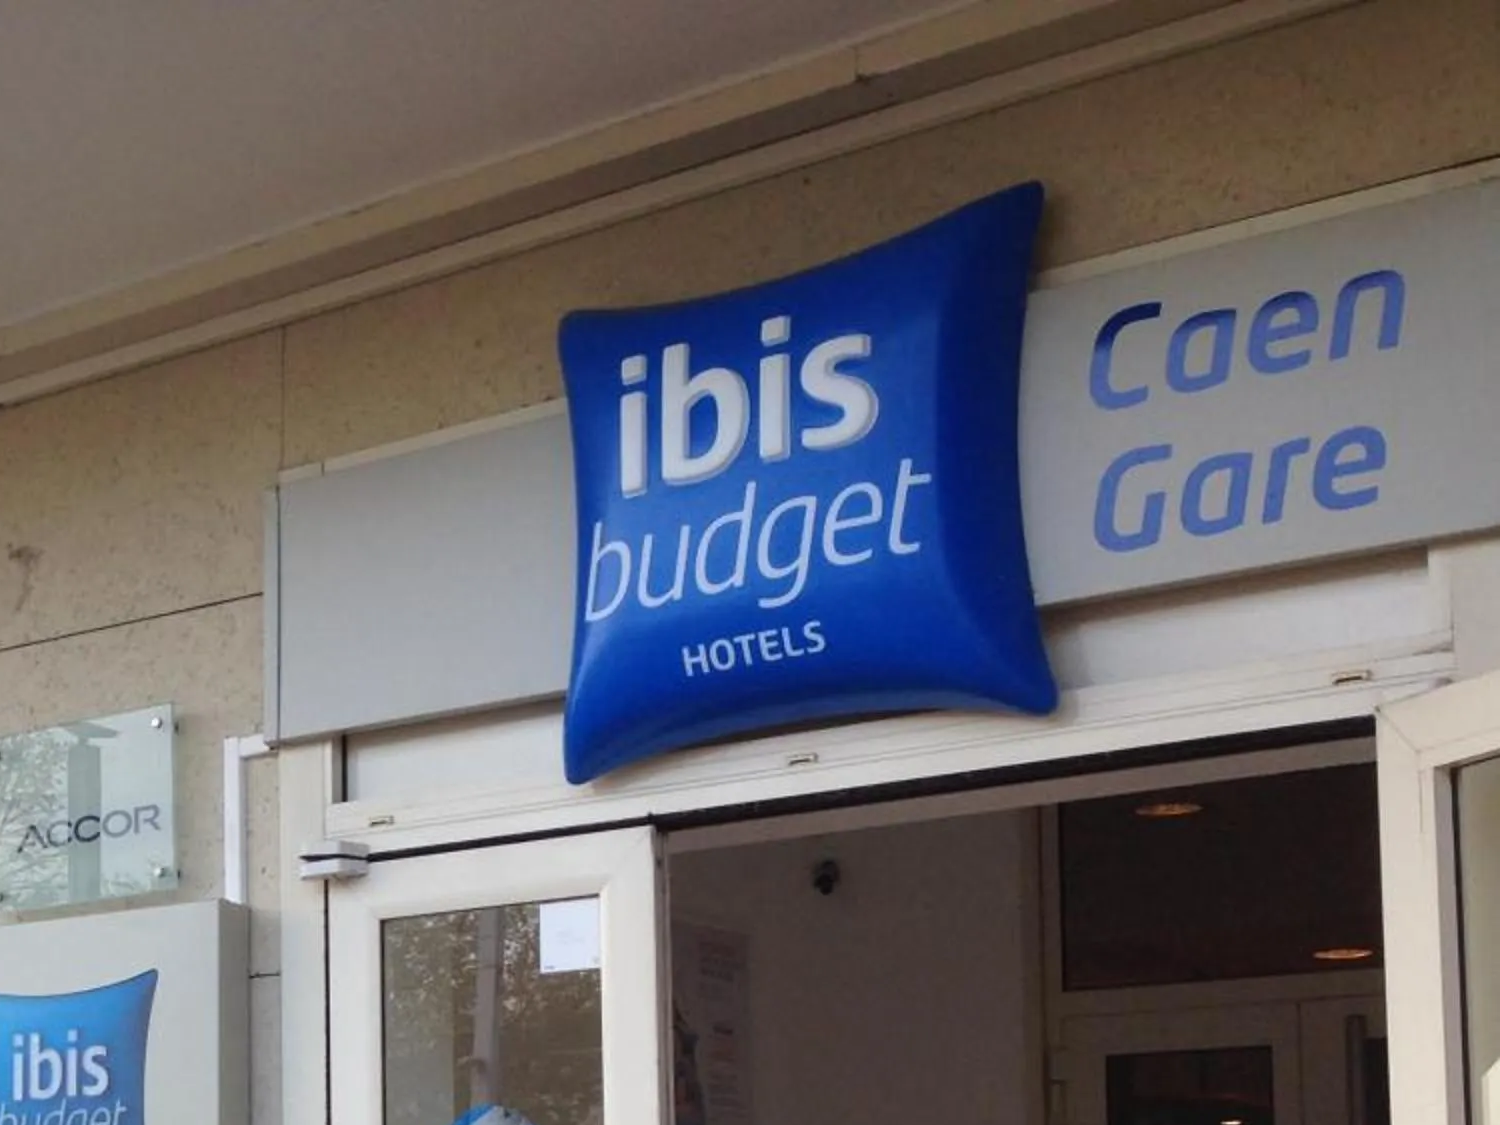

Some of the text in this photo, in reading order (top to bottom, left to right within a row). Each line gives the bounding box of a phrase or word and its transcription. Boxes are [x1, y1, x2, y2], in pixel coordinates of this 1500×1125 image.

[1089, 269, 1406, 411] Caen
[619, 315, 880, 499] ibis
[584, 458, 933, 623] budget
[1093, 425, 1388, 553] Gare
[682, 620, 828, 677] HOTELS
[16, 803, 162, 854] ACCOR
[11, 1028, 110, 1101] ibis
